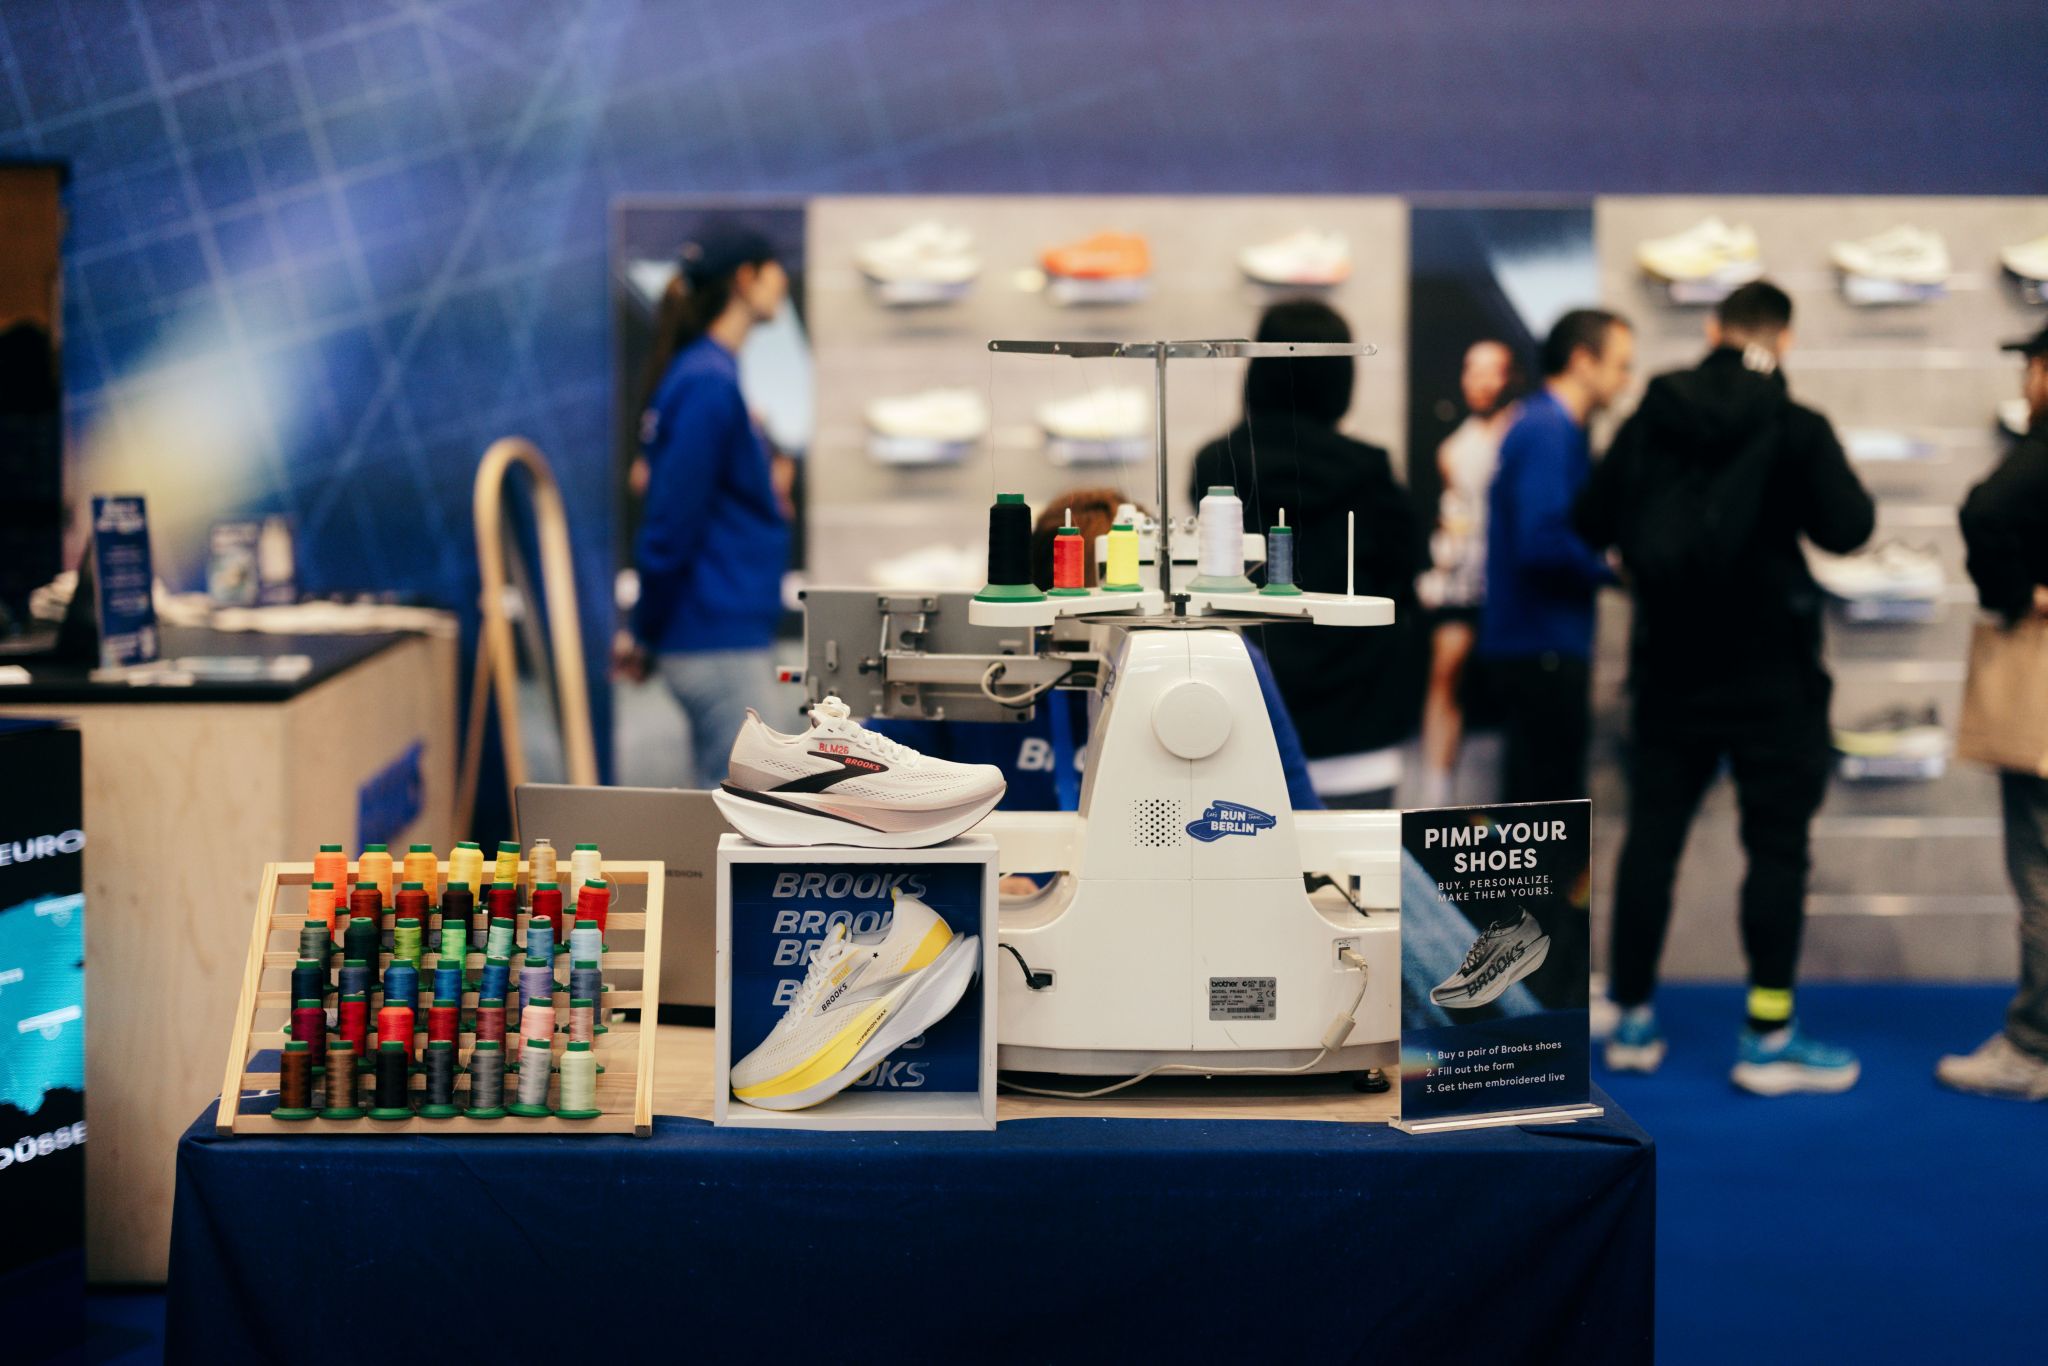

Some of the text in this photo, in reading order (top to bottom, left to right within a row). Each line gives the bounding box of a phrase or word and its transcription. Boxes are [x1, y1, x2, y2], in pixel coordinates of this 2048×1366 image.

[845, 757, 880, 771] BROOKS
[1220, 810, 1246, 821] RUN
[1211, 821, 1254, 833] BERLIN
[1425, 820, 1567, 849] PIMP YOUR
[0, 829, 86, 867] EURO
[1453, 848, 1537, 873] SHOES
[772, 872, 931, 899] BROOKS
[1438, 875, 1553, 891] BUY. PERSONALIZE.
[1438, 886, 1553, 903] MAKE THEM YOURS.
[772, 910, 893, 935] BROO
[1466, 940, 1526, 999] BROOKS
[1211, 980, 1238, 988] brother
[821, 982, 848, 1011] BROOKS
[876, 1009, 887, 1021] MAX
[1426, 1052, 1433, 1061] 1.
[1438, 1051, 1456, 1060] Buy
[1467, 1047, 1487, 1059] pair
[1488, 1046, 1499, 1055] of
[1501, 1043, 1533, 1054] Brooks
[1535, 1041, 1562, 1051] shoes
[1426, 1062, 1515, 1077] 2. Fill out the form
[1426, 1073, 1565, 1093] 3. Get them embroidered live
